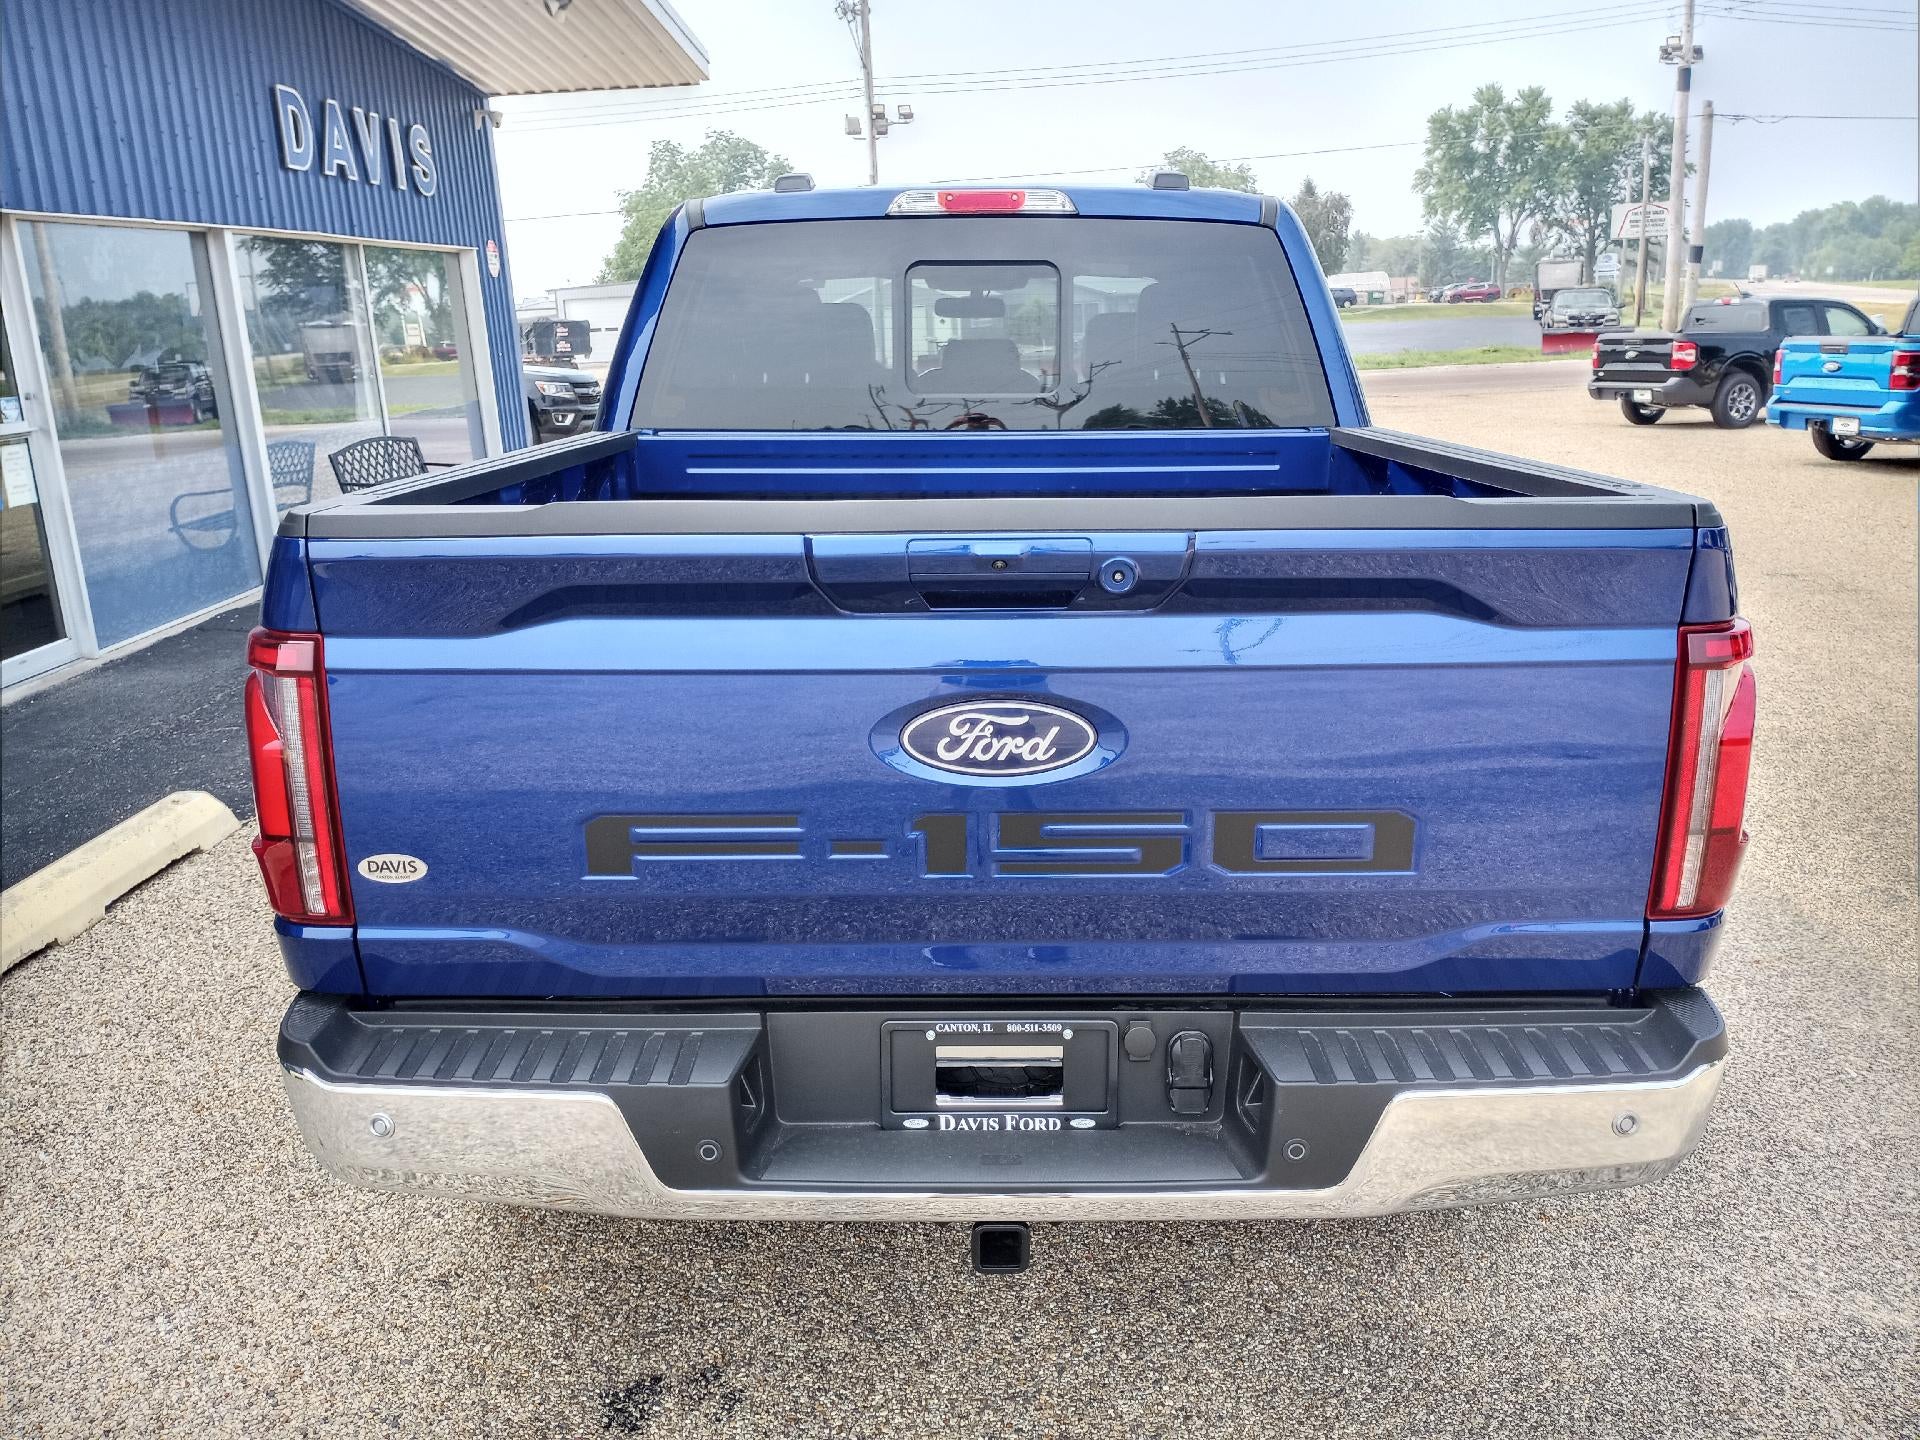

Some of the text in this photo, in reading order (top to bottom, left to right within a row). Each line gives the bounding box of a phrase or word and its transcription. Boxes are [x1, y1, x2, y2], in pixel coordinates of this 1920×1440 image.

[275, 83, 437, 197] DAVIS
[936, 712, 1061, 762] Ford
[582, 808, 1421, 880] F-150
[367, 860, 418, 874] DAVIS
[935, 1023, 994, 1034] CANTON, IL
[938, 1114, 1062, 1131] DAVIS FORD
